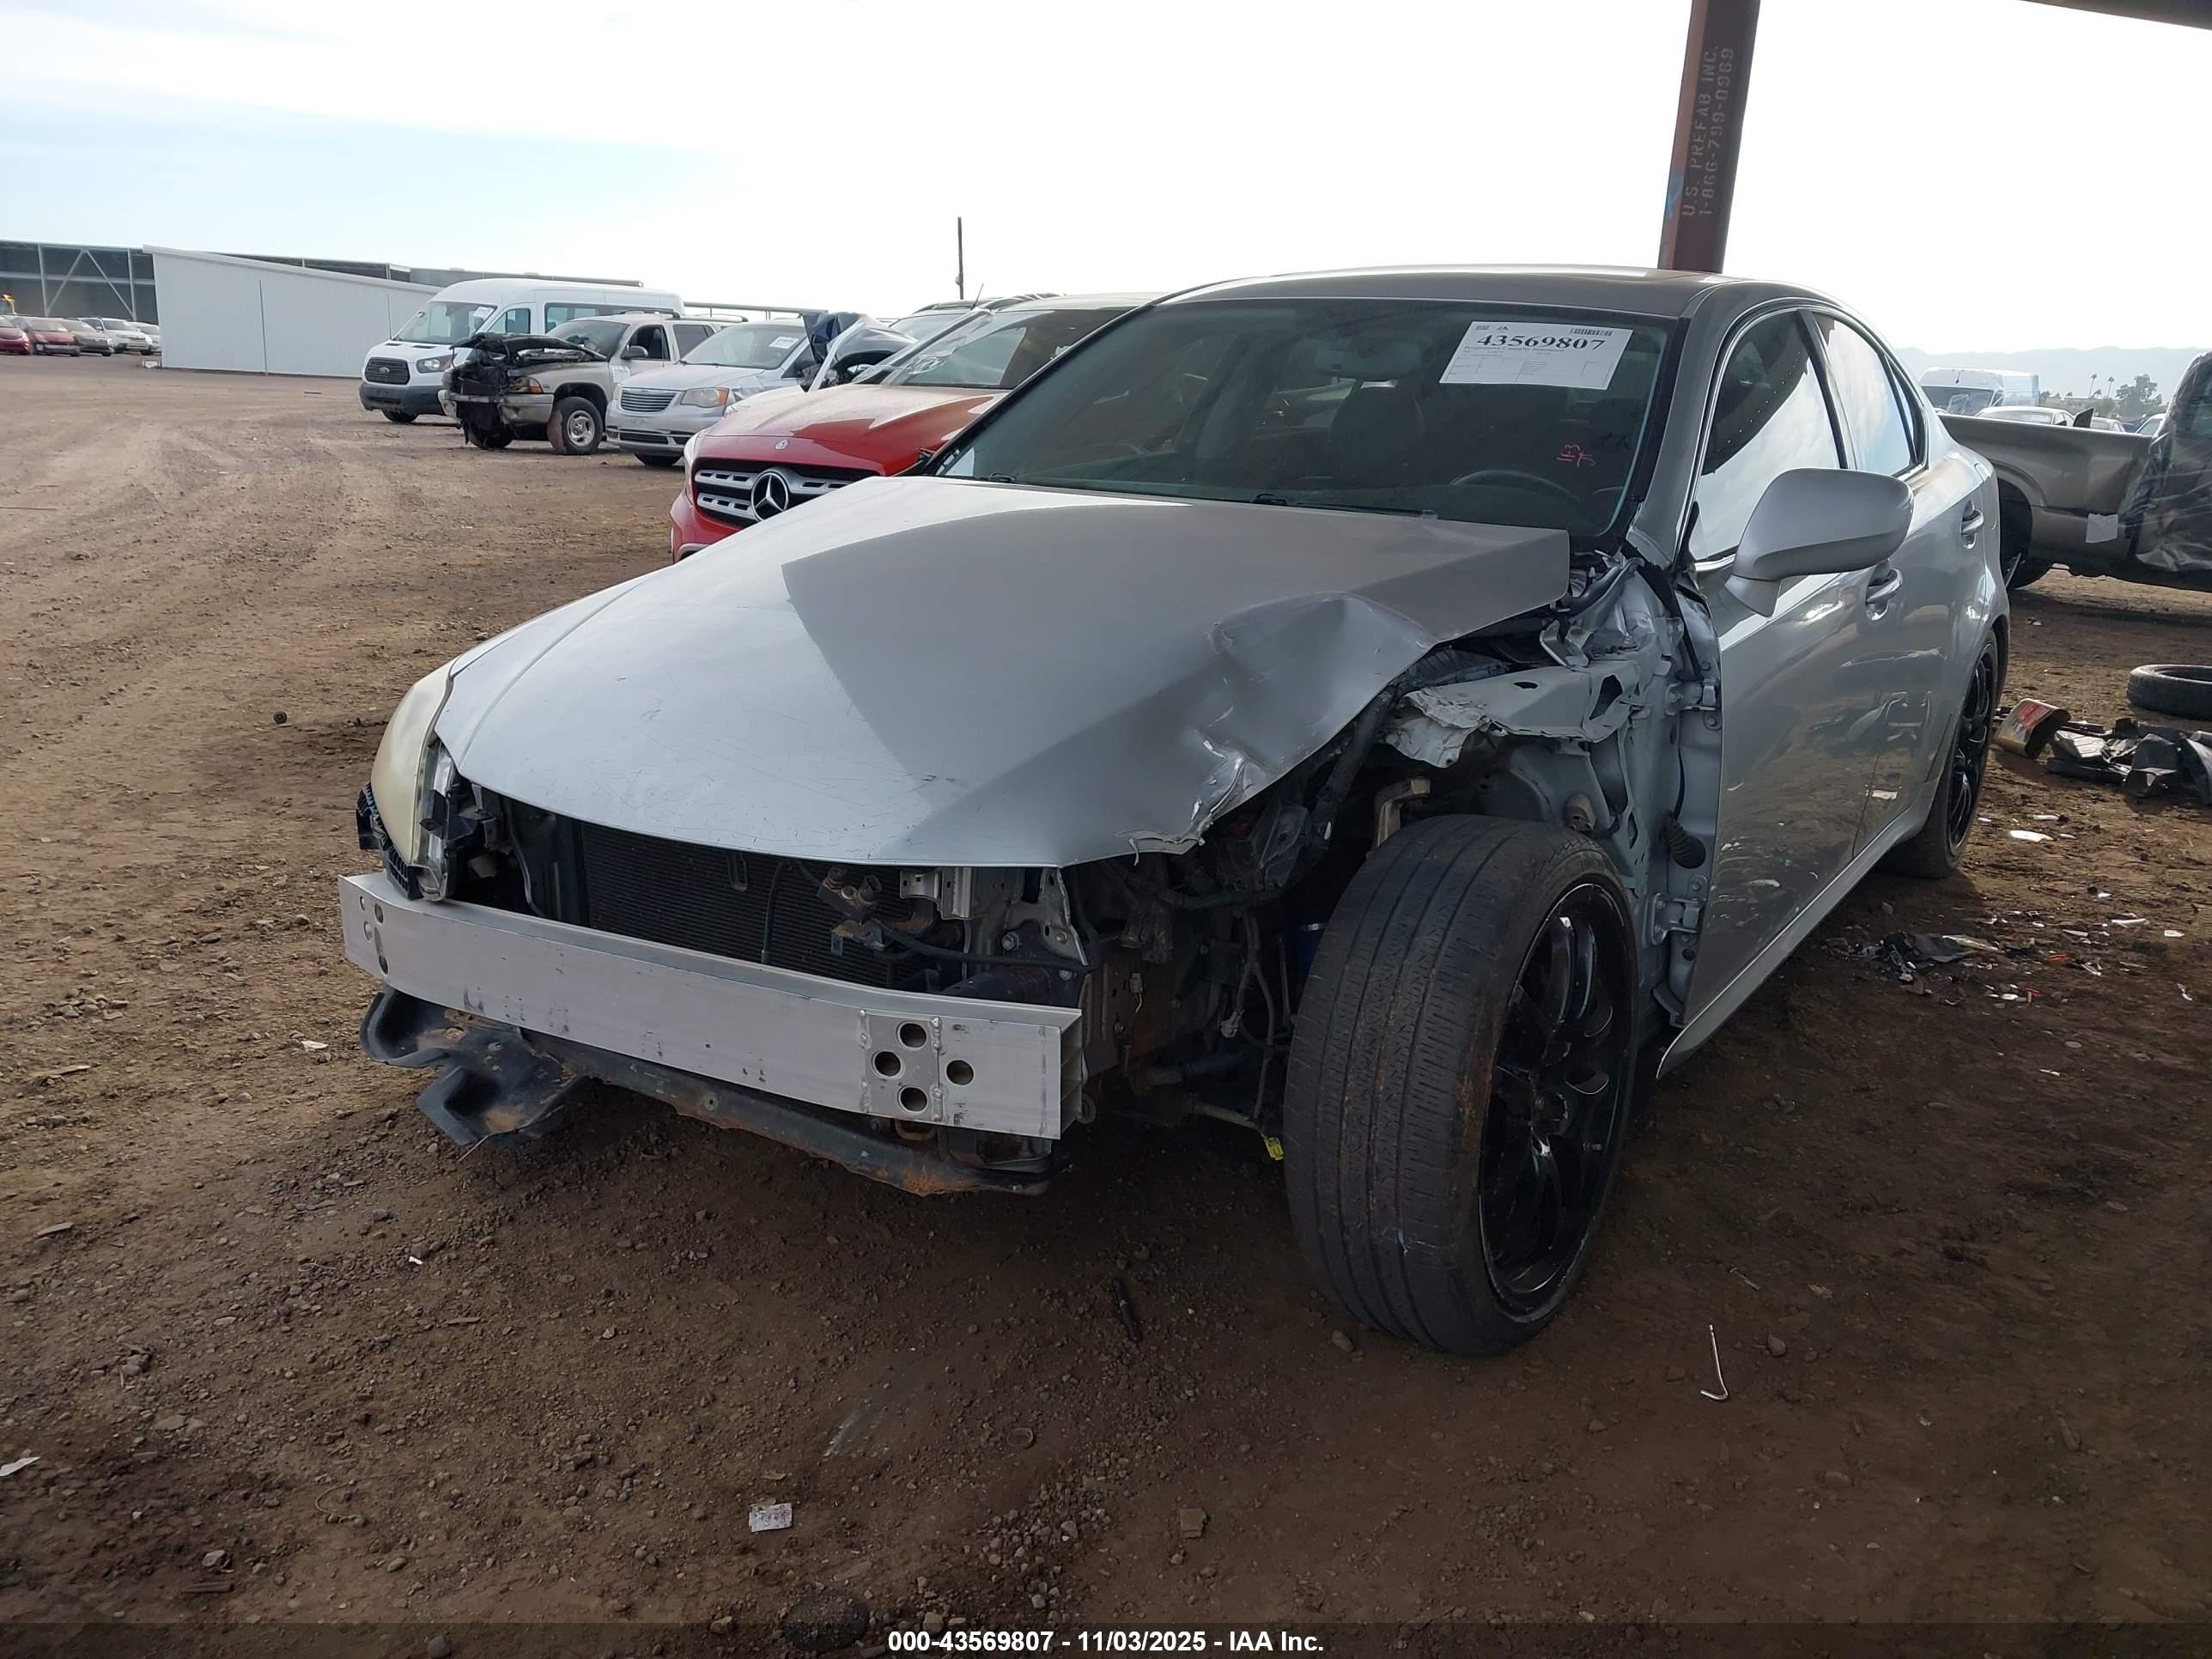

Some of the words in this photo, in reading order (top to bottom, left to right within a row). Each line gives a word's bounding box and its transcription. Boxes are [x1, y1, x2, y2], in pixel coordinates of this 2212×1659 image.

[1682, 180, 1700, 217] U.S.
[1691, 94, 1711, 169] PREFAB
[1701, 46, 1718, 82] INC.
[1476, 333, 1607, 351] 43569807
